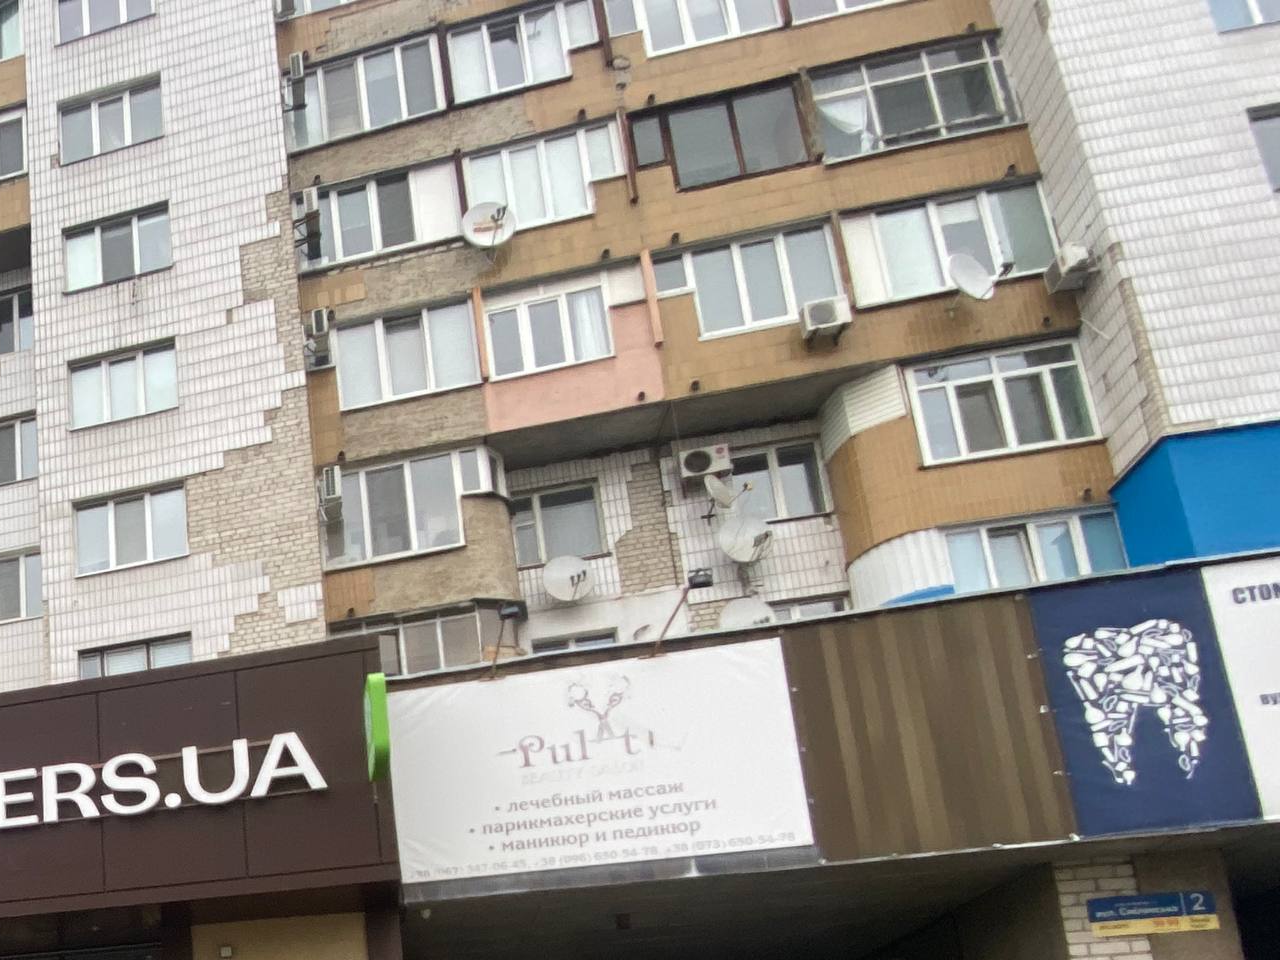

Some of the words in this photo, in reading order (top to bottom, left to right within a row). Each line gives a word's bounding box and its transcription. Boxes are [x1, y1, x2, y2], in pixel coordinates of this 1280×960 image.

[507, 790, 603, 813] лечебный
[609, 782, 684, 801] массаж
[482, 806, 644, 836] парикмахерские
[649, 799, 718, 820] услуги
[502, 832, 590, 852] маникюр
[596, 830, 607, 843] и
[613, 820, 701, 842] педикюр
[1190, 892, 1206, 911] 2
